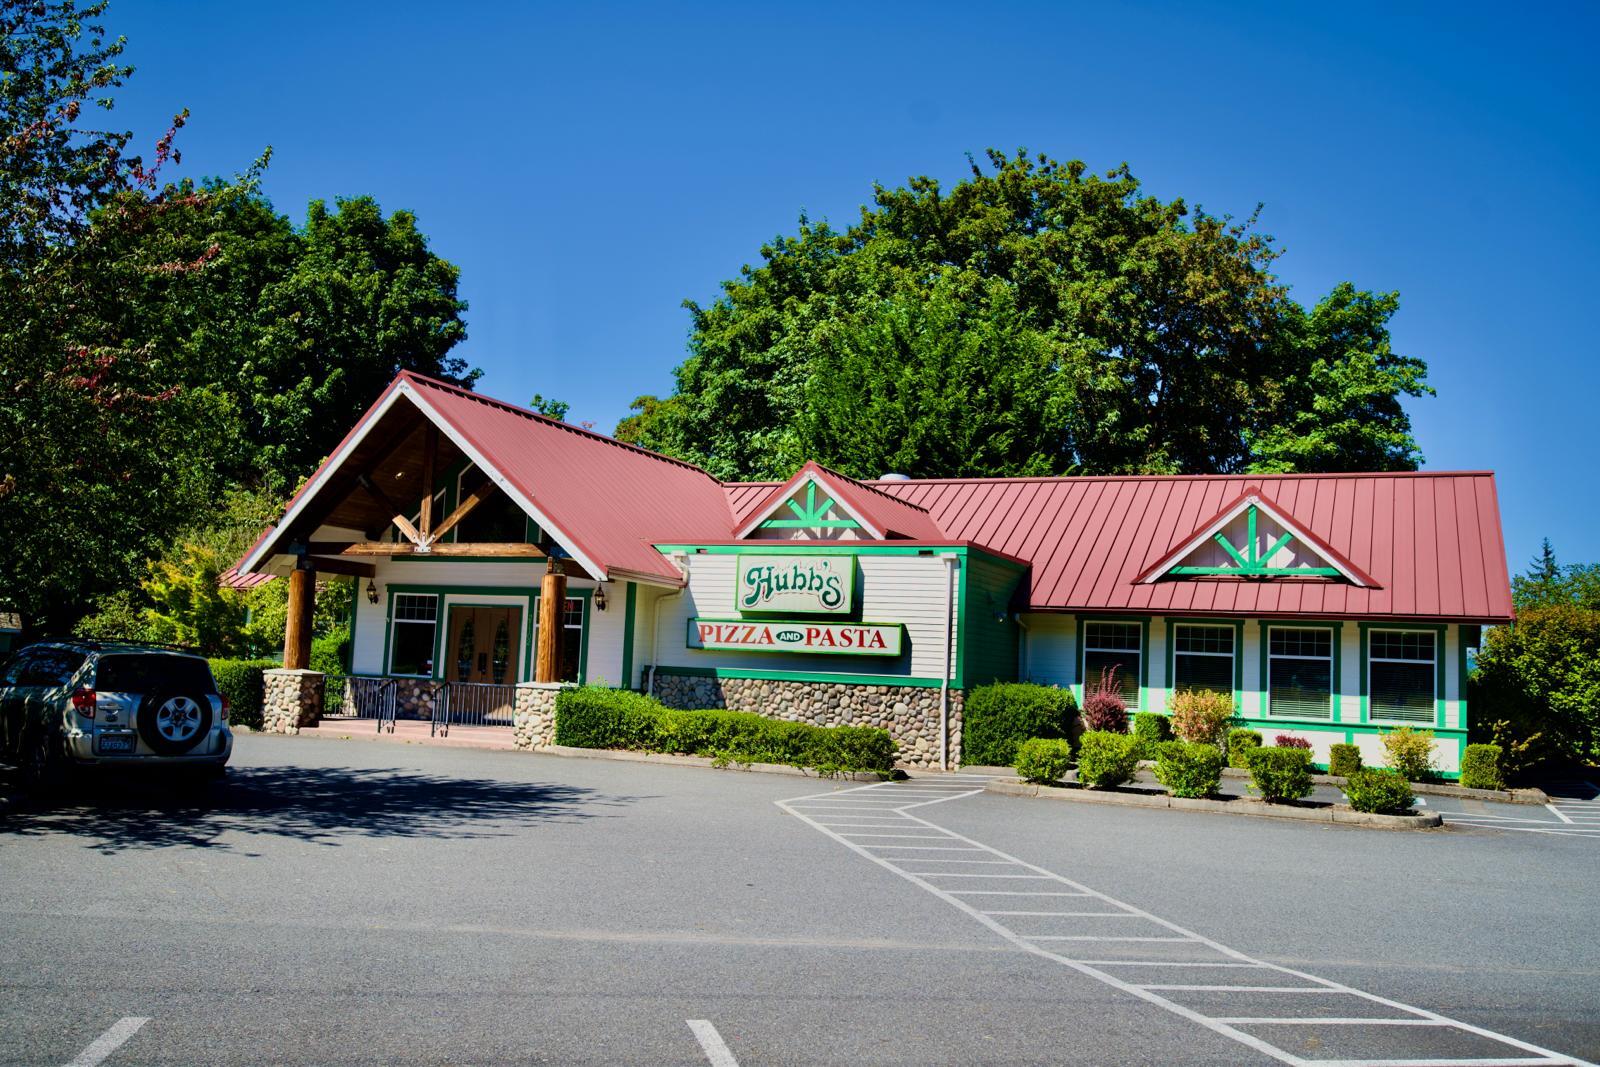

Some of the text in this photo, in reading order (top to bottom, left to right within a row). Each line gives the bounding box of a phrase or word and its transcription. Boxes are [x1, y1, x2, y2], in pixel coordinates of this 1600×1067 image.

[744, 561, 842, 607] Hubb's
[699, 624, 888, 649] PIZZA AND PASTA
